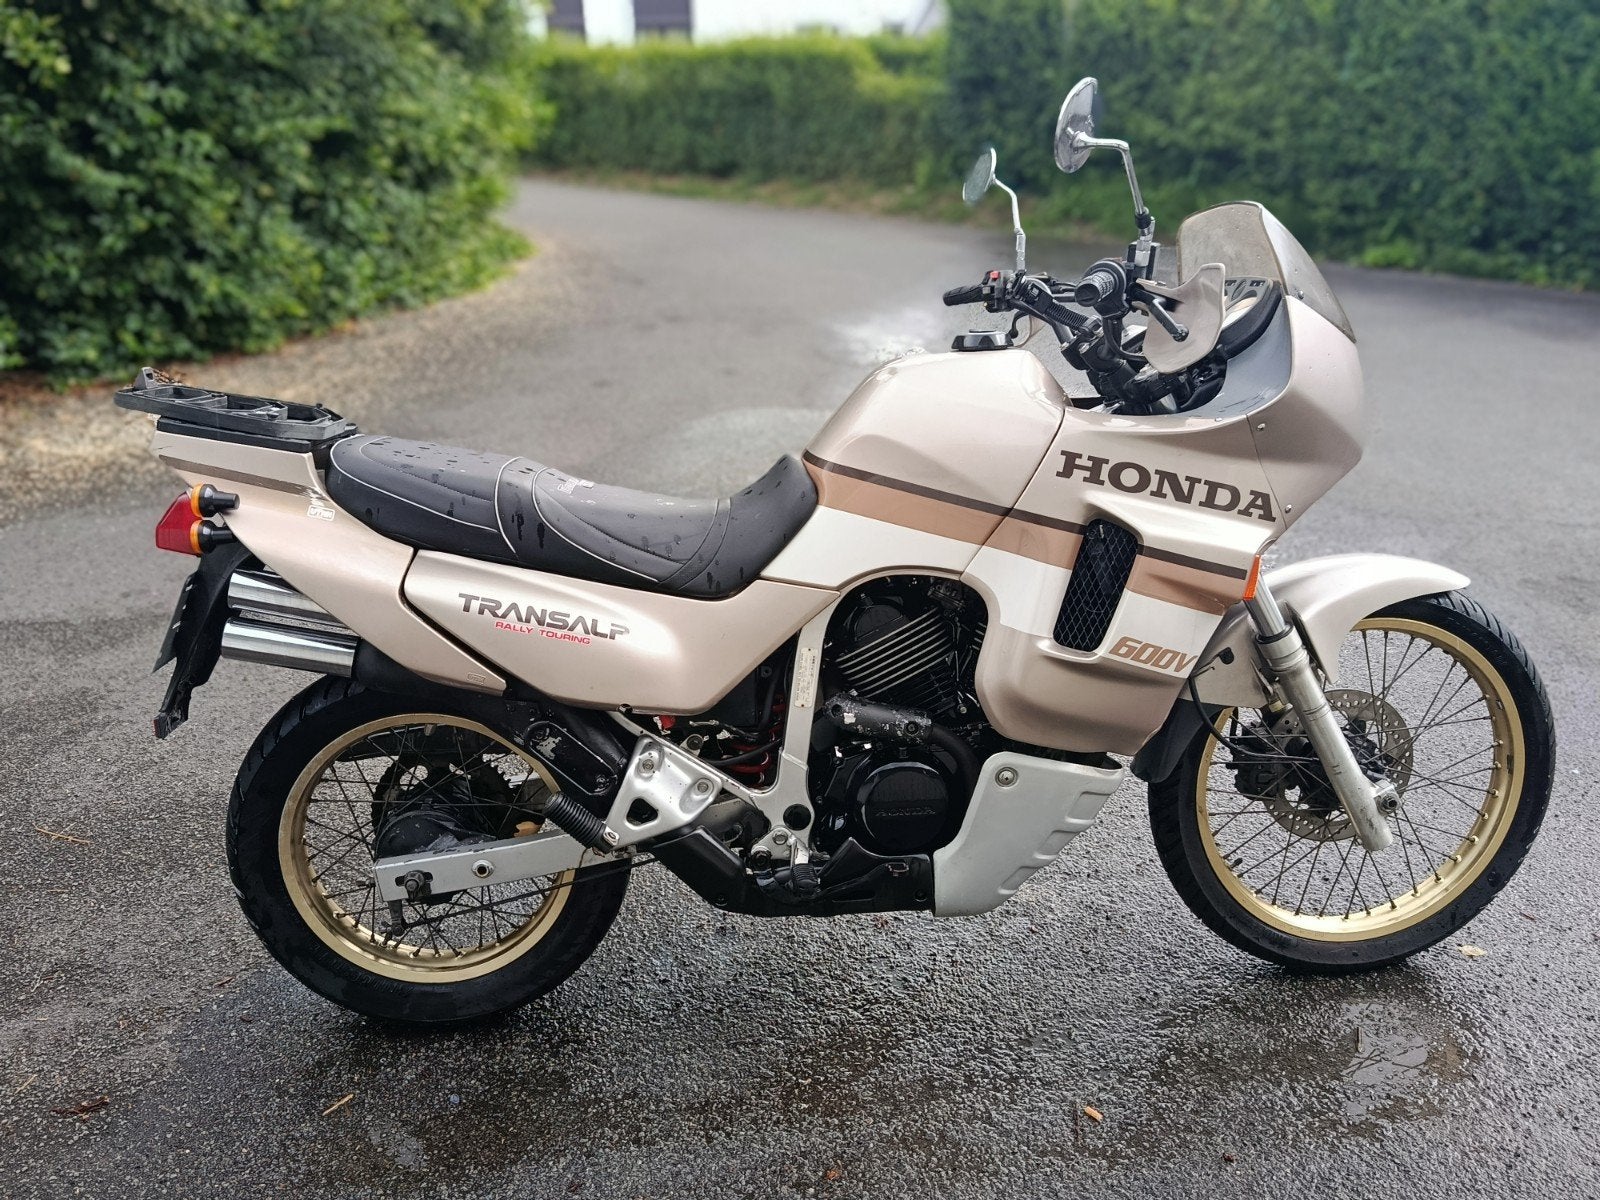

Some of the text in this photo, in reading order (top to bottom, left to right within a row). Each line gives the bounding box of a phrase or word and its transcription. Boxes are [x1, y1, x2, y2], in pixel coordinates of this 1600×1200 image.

[1055, 450, 1277, 522] HONDA
[458, 592, 630, 640] TRANSALP
[495, 621, 592, 645] RALLY TOURING
[1108, 636, 1199, 673] 600V
